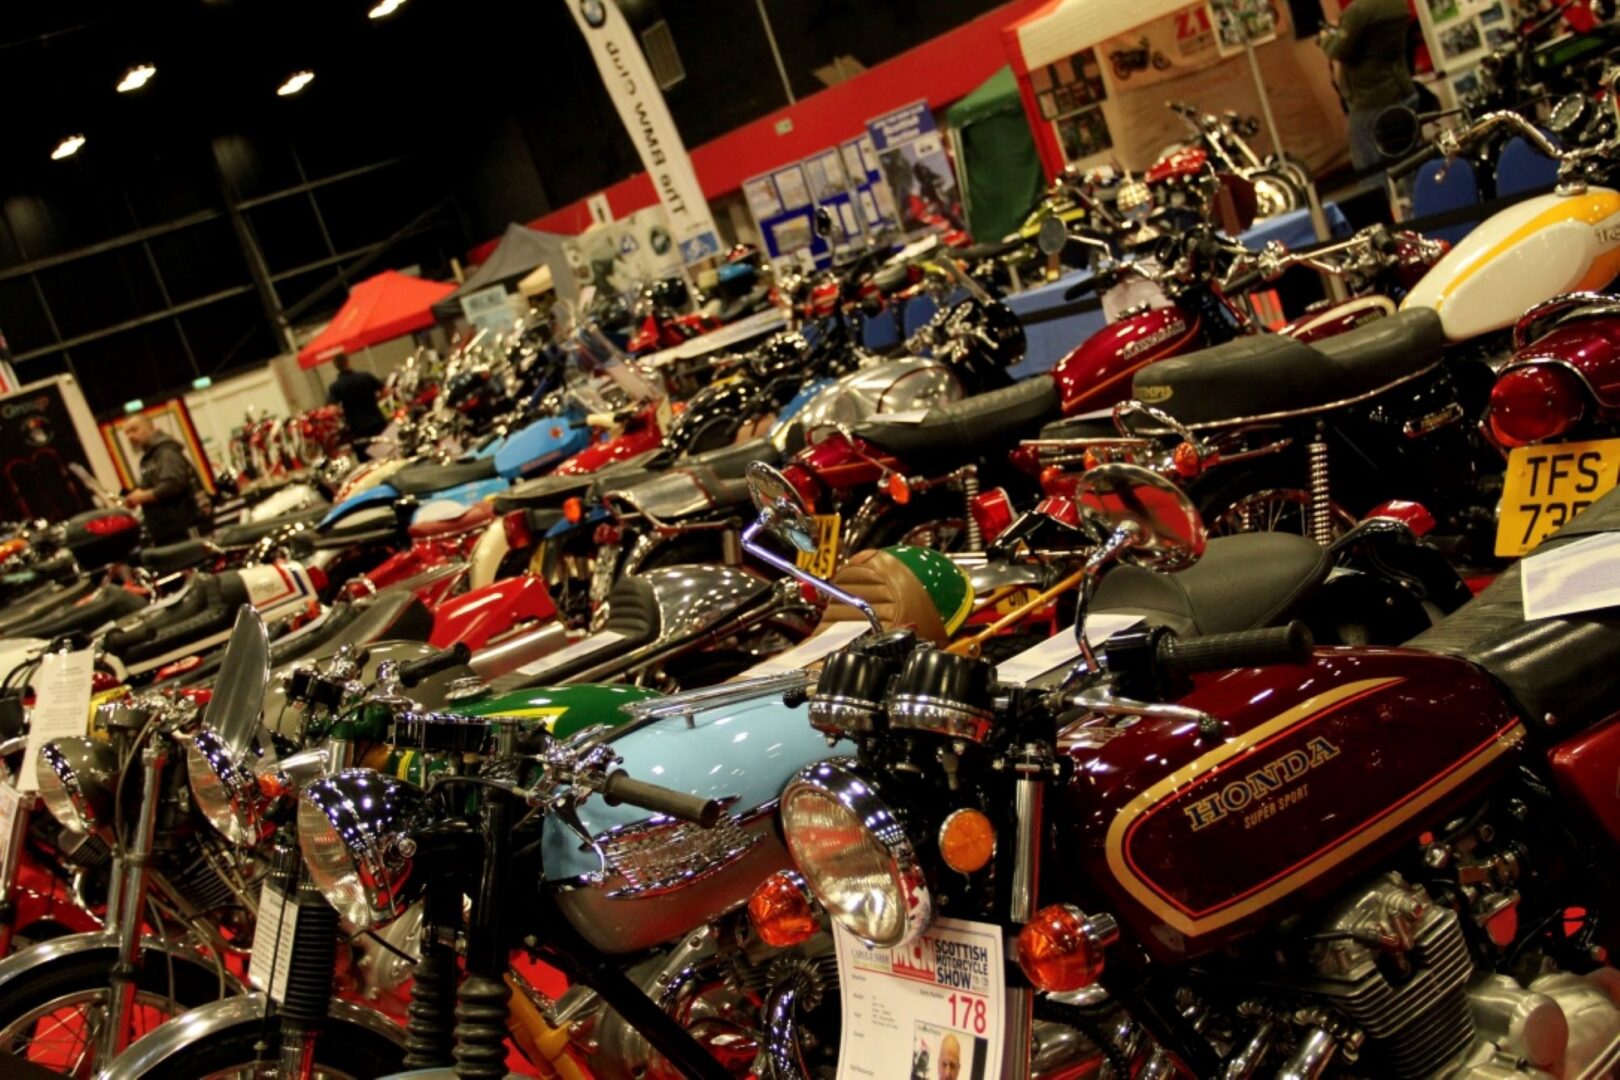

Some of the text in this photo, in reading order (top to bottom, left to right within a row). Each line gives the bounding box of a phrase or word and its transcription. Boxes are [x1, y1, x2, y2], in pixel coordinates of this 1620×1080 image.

[1527, 452, 1602, 497] TFS
[1183, 736, 1341, 832] HONDA
[1244, 784, 1310, 829] SUPER SPORT
[892, 935, 935, 973] MCN
[935, 938, 988, 962] SCOTTISH
[935, 953, 988, 976] MOTORCYCLE
[937, 967, 972, 989] SHOW
[948, 993, 987, 1034] 178
